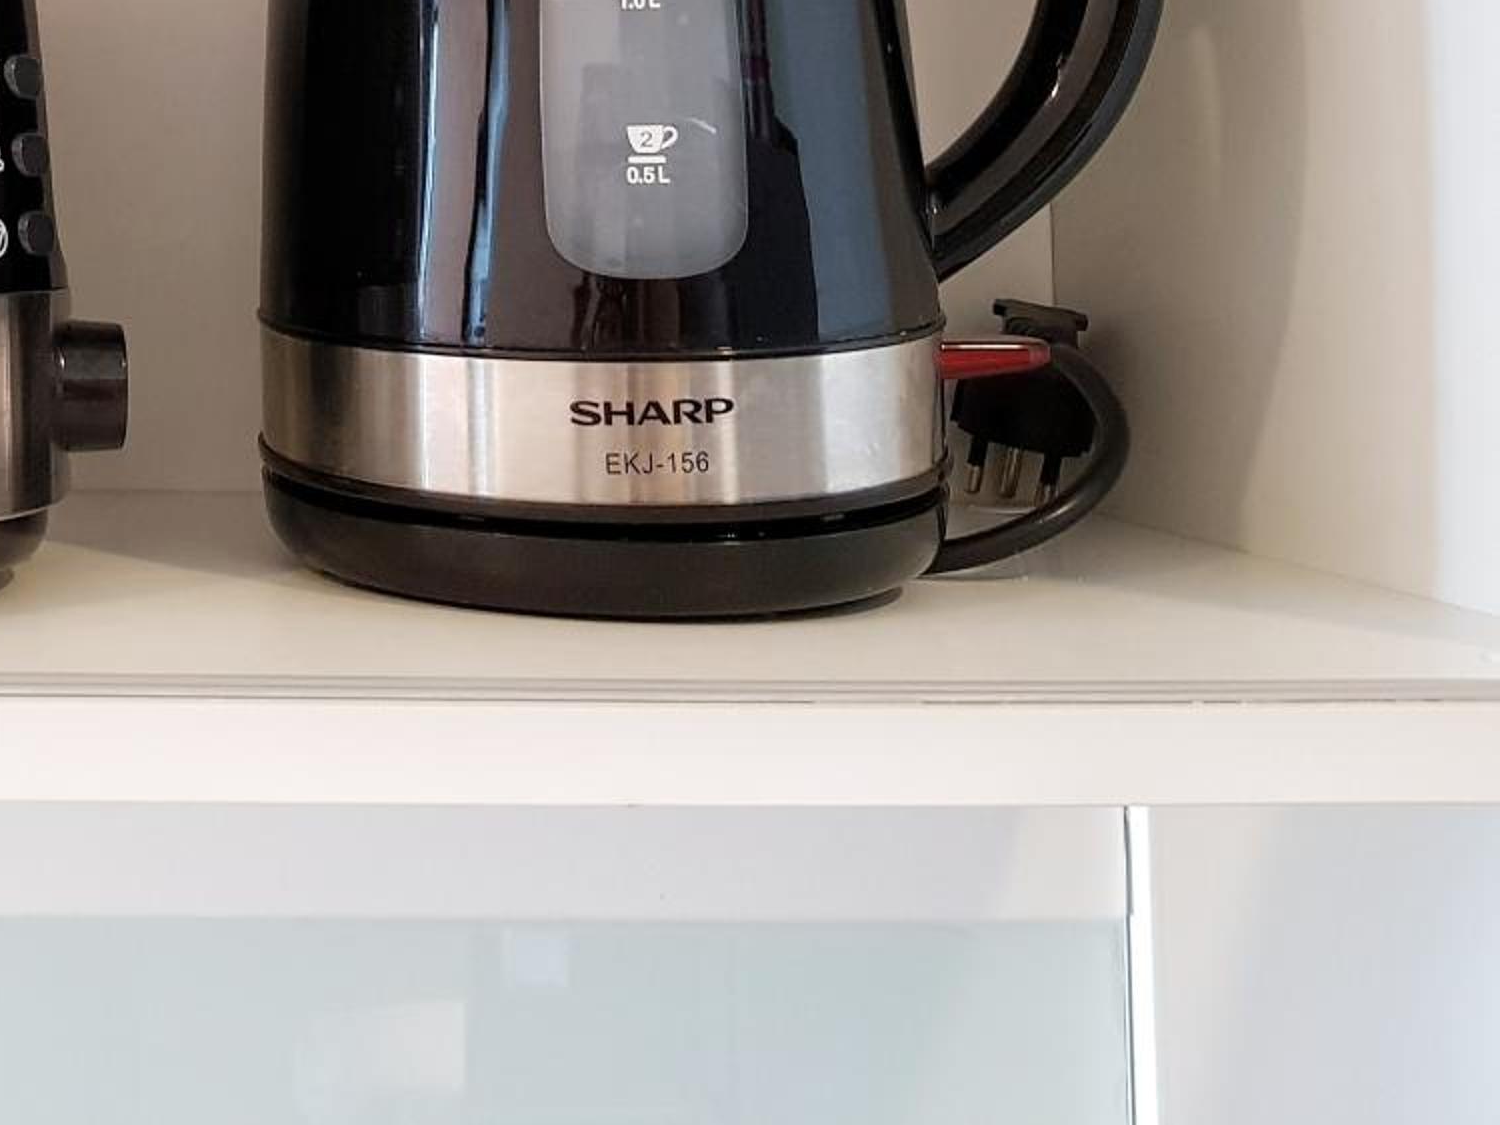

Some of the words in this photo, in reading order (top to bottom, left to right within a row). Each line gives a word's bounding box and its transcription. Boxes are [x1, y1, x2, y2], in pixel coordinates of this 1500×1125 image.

[640, 130, 653, 148] 2
[569, 398, 735, 426] SHARP
[605, 451, 710, 475] EKJ-156
